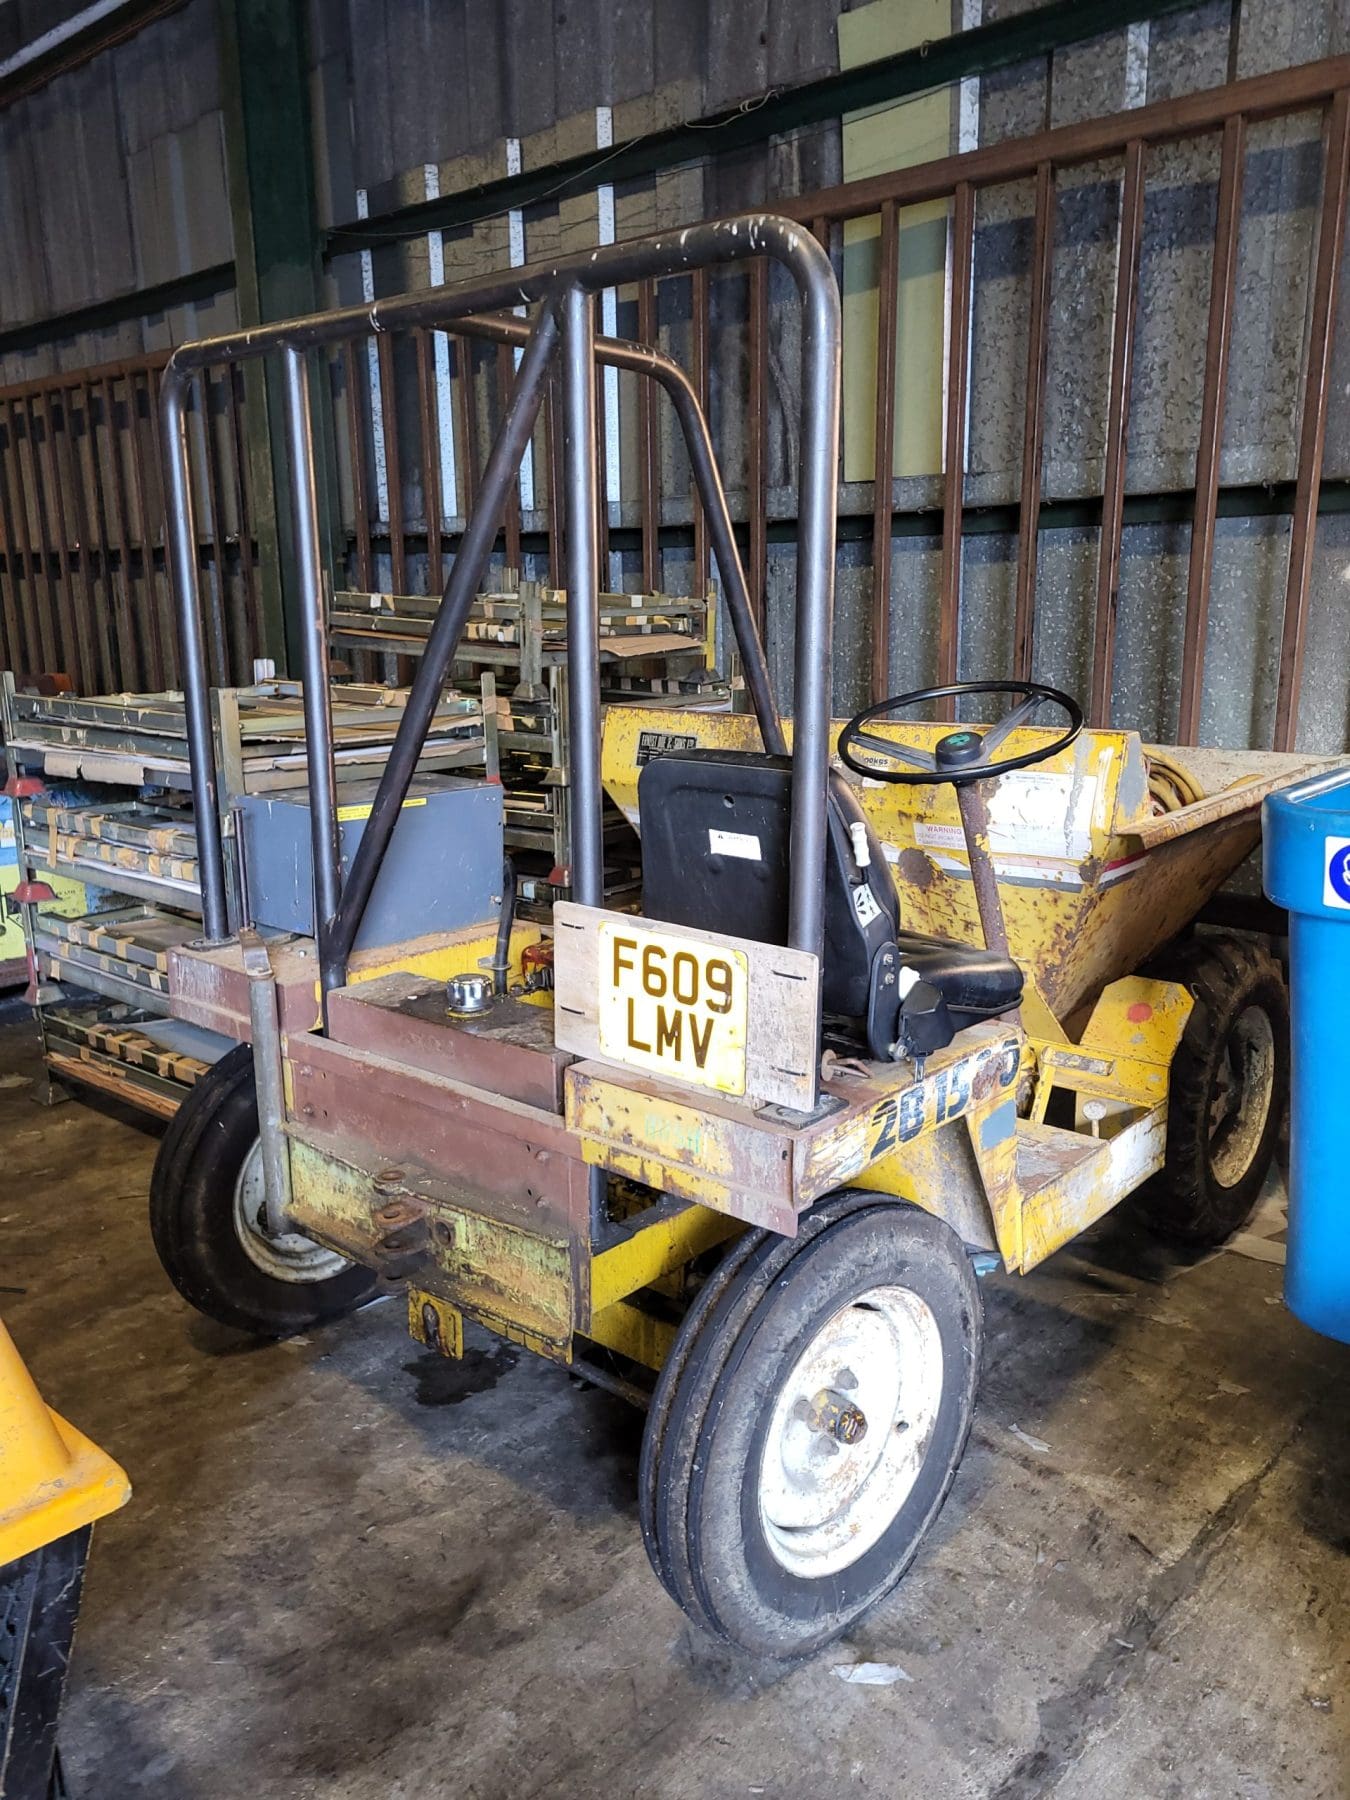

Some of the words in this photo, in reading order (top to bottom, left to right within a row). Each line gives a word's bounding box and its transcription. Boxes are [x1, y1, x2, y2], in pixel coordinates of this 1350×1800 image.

[927, 825, 962, 835] WARNING
[613, 936, 733, 1015] F609
[627, 997, 714, 1069] LMV
